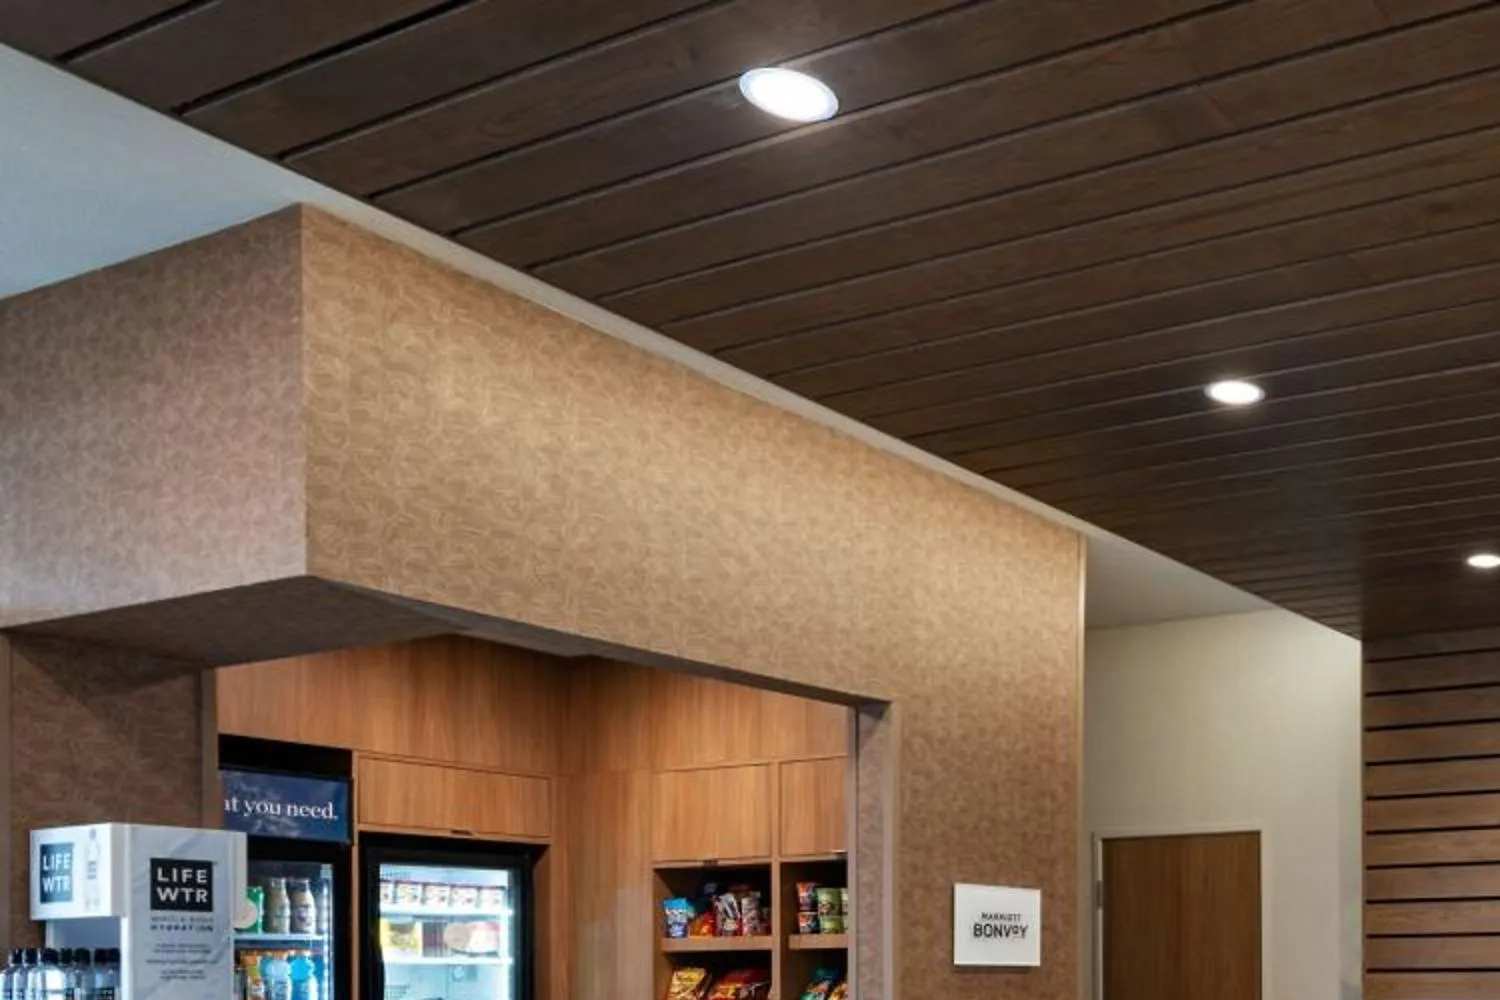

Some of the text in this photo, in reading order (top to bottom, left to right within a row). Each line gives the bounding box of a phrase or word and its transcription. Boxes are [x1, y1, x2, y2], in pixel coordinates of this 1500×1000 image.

[243, 800, 280, 817] you
[287, 802, 339, 820] need.
[43, 853, 70, 871] LIFE
[157, 867, 208, 883] LIFE
[42, 876, 69, 893] WTR
[157, 887, 208, 903] WTR
